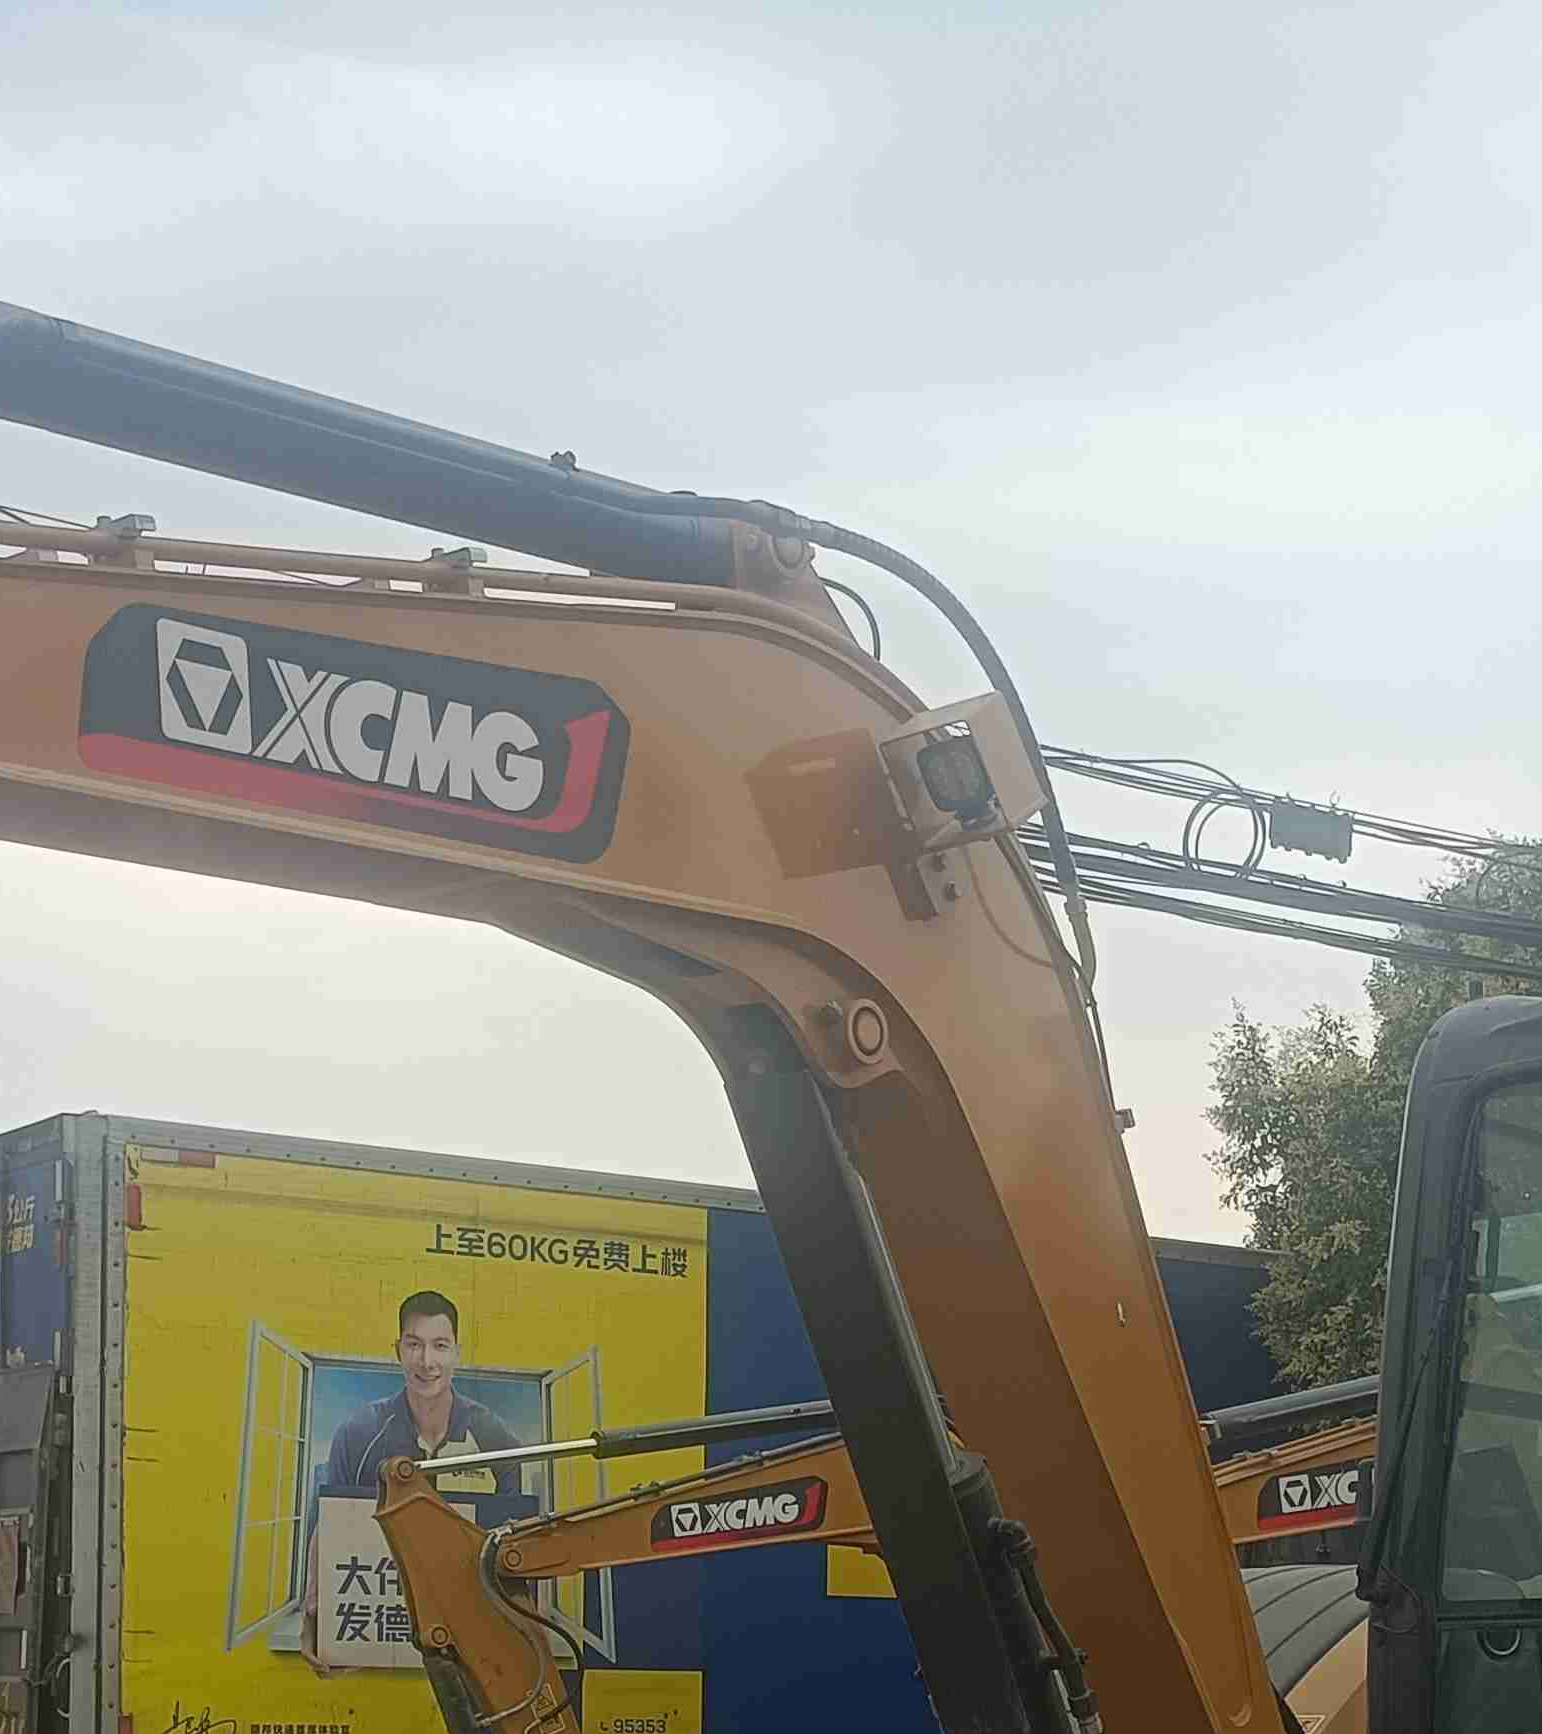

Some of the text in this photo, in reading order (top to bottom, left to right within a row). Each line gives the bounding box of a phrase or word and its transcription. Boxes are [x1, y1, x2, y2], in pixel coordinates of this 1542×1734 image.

[252, 657, 545, 812] XCMG
[425, 1223, 689, 1279] 上至60KG免费上楼
[704, 1493, 799, 1534] XCMG
[613, 1719, 667, 1734] 95353
